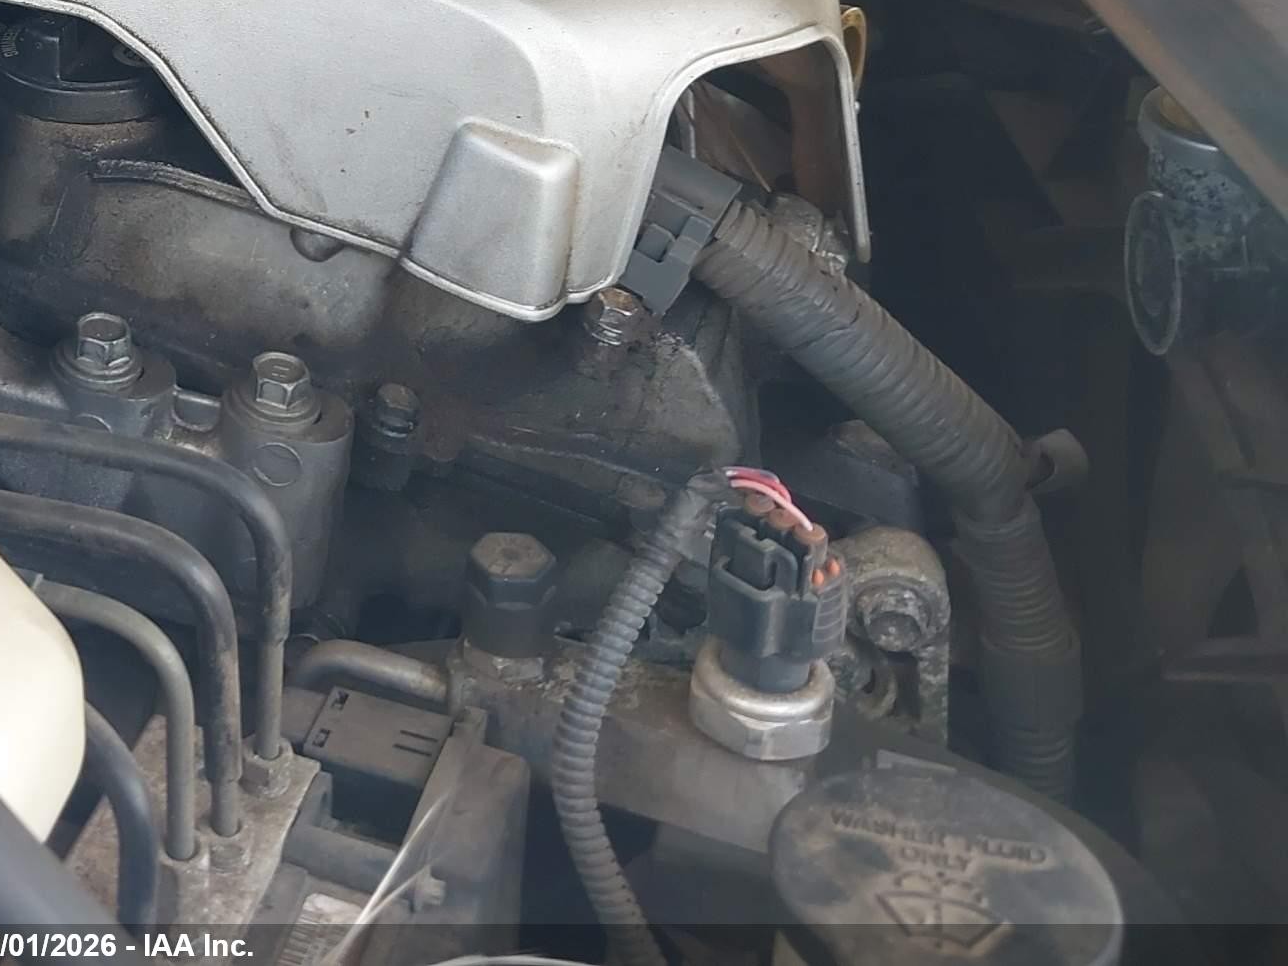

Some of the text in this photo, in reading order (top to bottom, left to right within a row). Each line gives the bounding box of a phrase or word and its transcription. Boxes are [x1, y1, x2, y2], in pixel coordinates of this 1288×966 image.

[829, 808, 1047, 864] WASHER FLUID
[899, 845, 969, 872] ONLY
